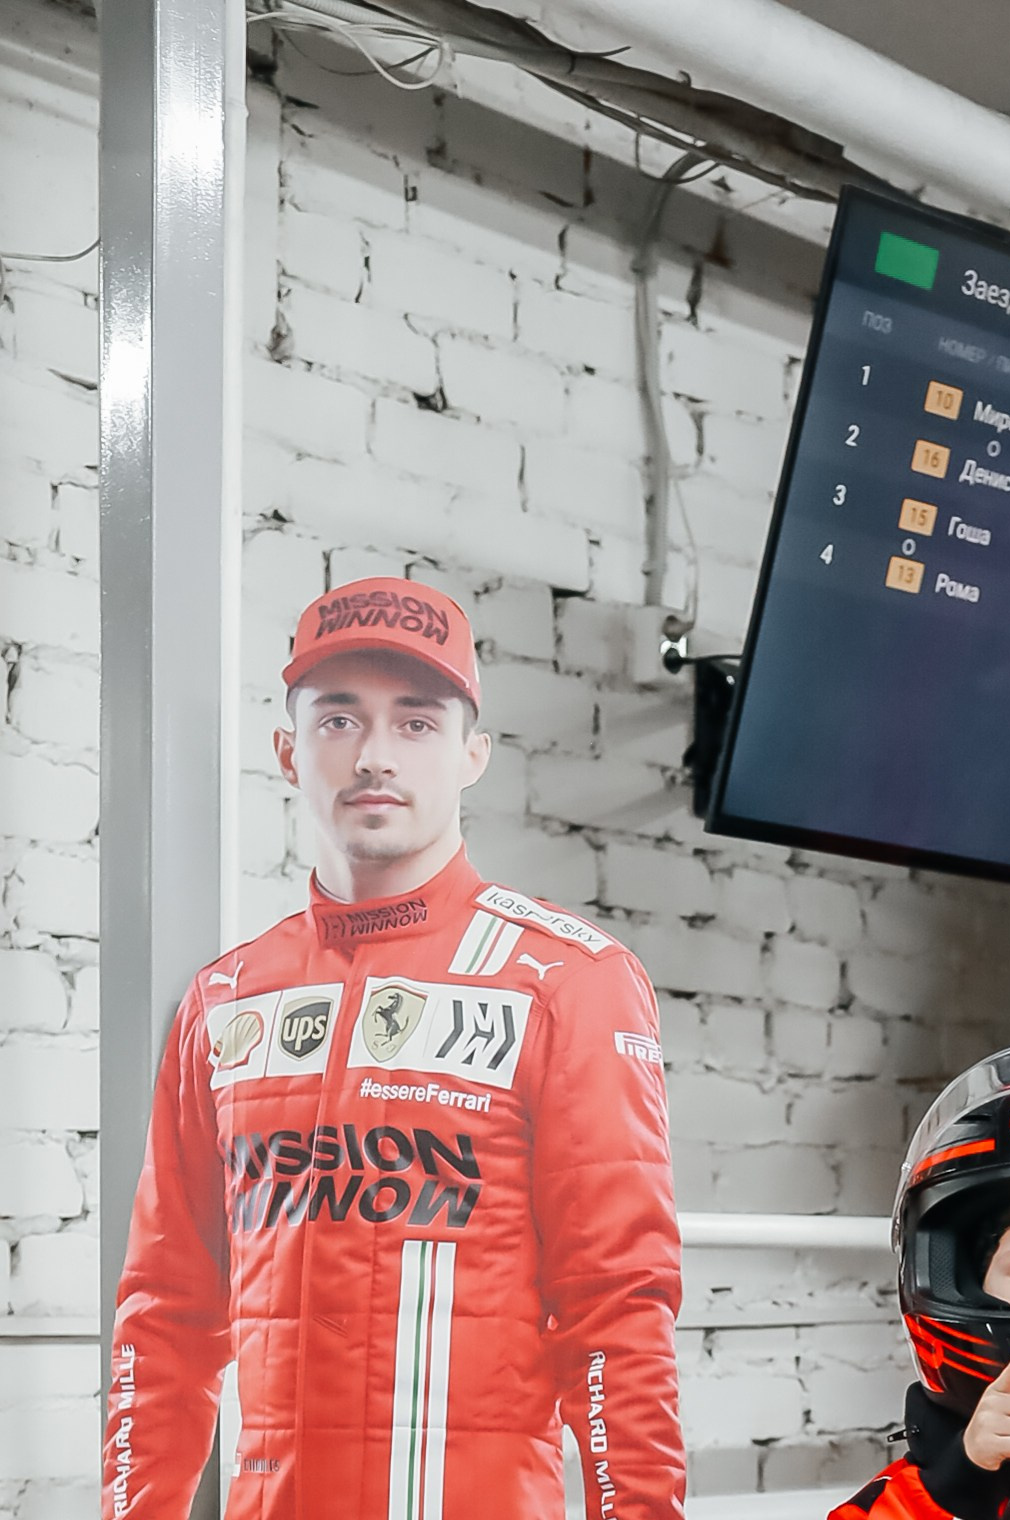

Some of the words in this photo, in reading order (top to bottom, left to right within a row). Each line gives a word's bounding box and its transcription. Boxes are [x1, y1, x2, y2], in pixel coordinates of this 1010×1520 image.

[861, 310, 893, 334] ПОЗ
[861, 365, 871, 386] 1
[845, 424, 860, 446] 2
[922, 448, 940, 469] 16
[833, 484, 847, 506] 3
[910, 507, 928, 526] 15
[947, 516, 992, 546] Гоша
[819, 544, 834, 565] 4
[897, 564, 915, 585] 13
[934, 573, 981, 603] Рома
[315, 608, 449, 646] WINNOW
[318, 591, 449, 631] MISSION
[346, 899, 427, 923] MISSION
[351, 909, 427, 936] WINNOW
[486, 891, 601, 944] kasrsky
[282, 1015, 327, 1051] ups
[360, 1078, 491, 1112] #essereFerrari
[118, 1343, 135, 1409] MILLE
[587, 1350, 608, 1454] RICHARD
[114, 1416, 133, 1518] RICHARD
